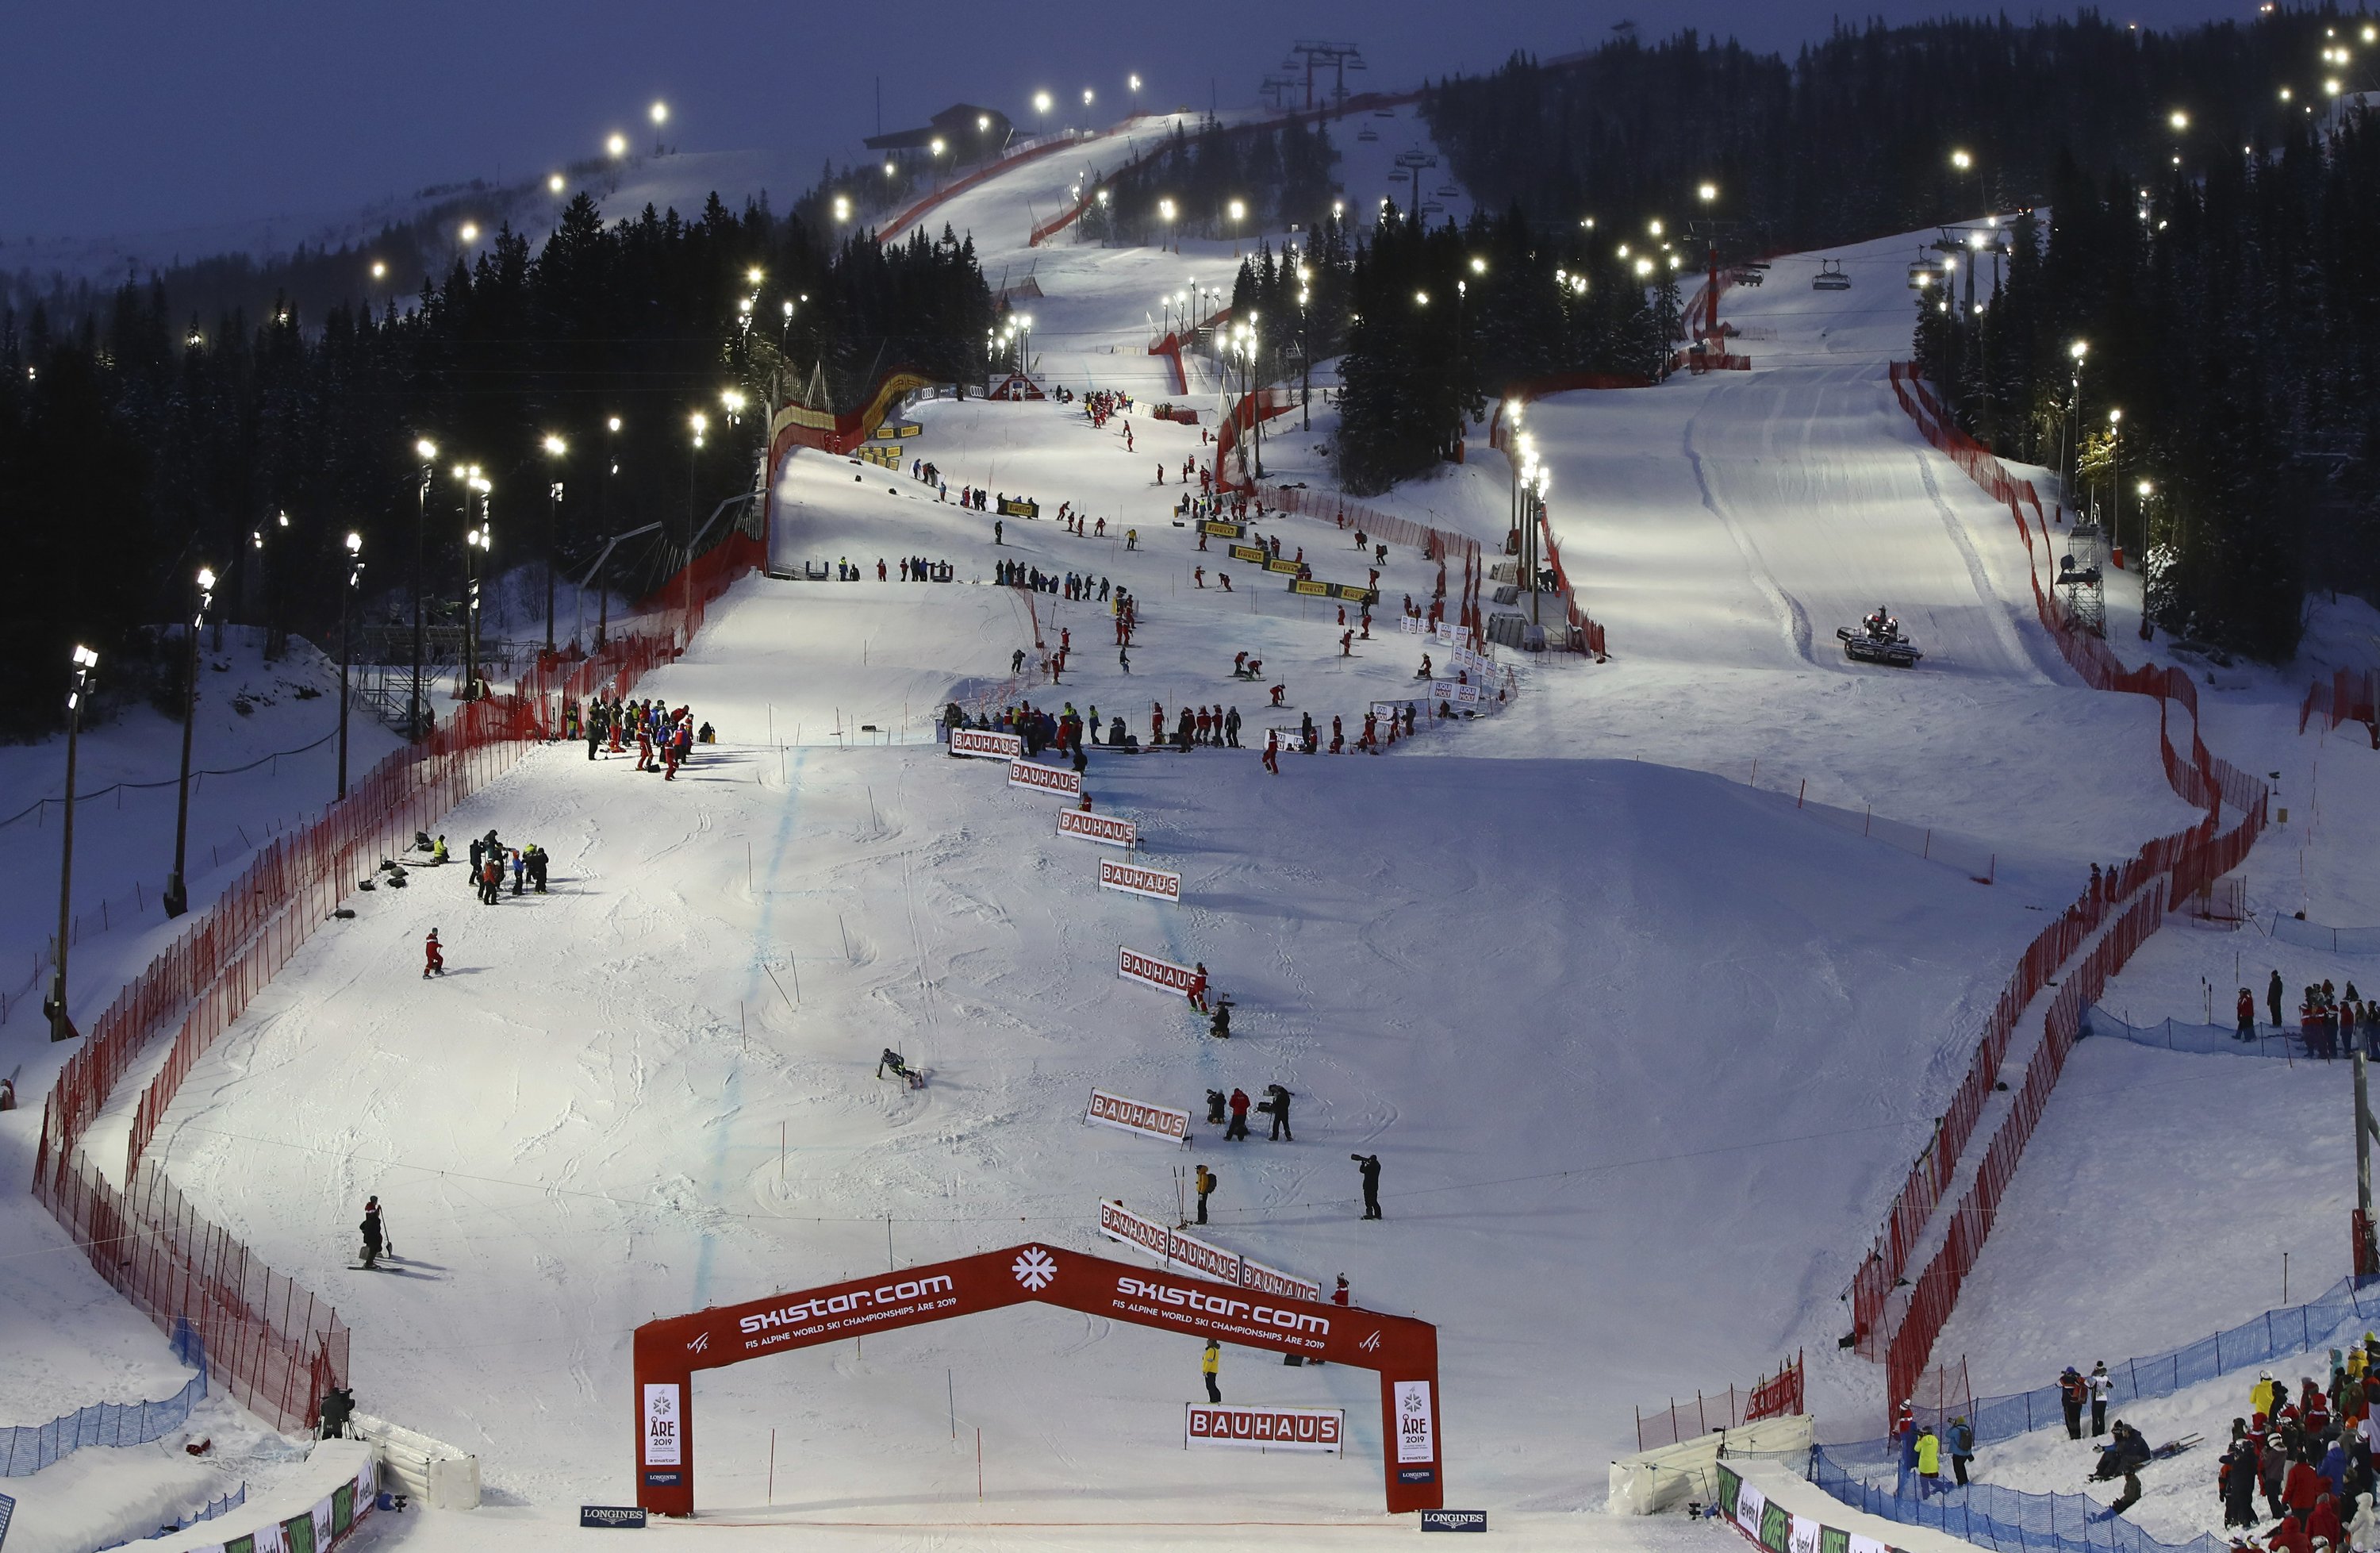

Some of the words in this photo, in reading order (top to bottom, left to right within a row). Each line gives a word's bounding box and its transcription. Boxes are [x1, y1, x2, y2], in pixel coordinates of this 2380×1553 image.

[955, 734, 1019, 754] BAUHAUS
[1012, 766, 1079, 790] BAUHAUS
[1061, 815, 1134, 840] BAUHAUS
[1103, 866, 1177, 893] BAUHAUS
[1092, 1097, 1184, 1133] BAUHAUS
[1103, 1206, 1166, 1251] BAUHAUS
[1169, 1237, 1238, 1278] BAUHAUS
[746, 1340, 758, 1349] FIS
[761, 1333, 790, 1346] ALPINE
[793, 1324, 824, 1337] WORLD
[827, 1322, 841, 1331] SKI
[843, 1306, 914, 1328] CHAMPIONSHIPS
[917, 1299, 935, 1312] ÅRE
[937, 1297, 957, 1309] 2019
[1112, 1299, 1125, 1309] FIS
[1127, 1303, 1158, 1316] ALPINE
[1161, 1310, 1192, 1324] WORLD
[1195, 1317, 1208, 1327] SKI
[1211, 1320, 1282, 1342] CHAMPIONSHIPS
[1284, 1333, 1302, 1345] ÅRE
[1305, 1339, 1325, 1349] 2019
[651, 1417, 675, 1437] ÅRE
[1193, 1413, 1336, 1438] BAUHAUS
[1402, 1414, 1427, 1435] ÅRE
[584, 1509, 643, 1520] LONGINES
[1424, 1513, 1484, 1523] LONGINES
